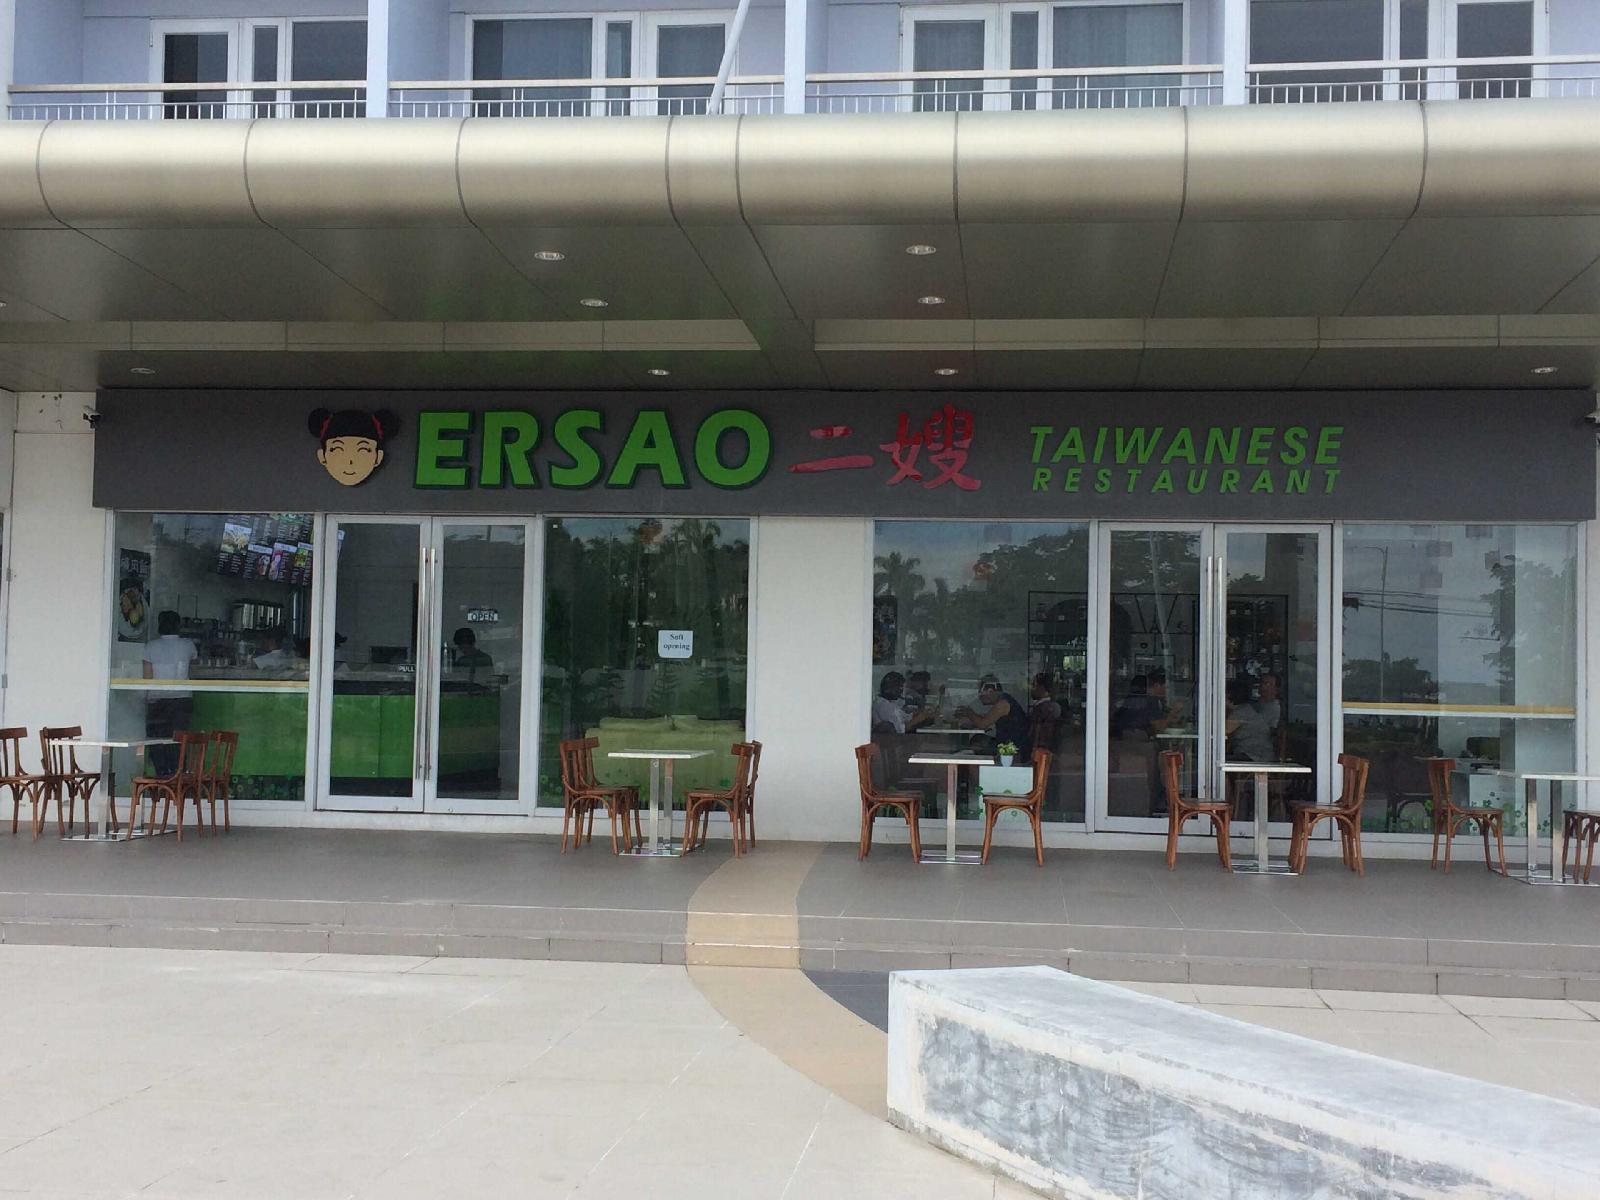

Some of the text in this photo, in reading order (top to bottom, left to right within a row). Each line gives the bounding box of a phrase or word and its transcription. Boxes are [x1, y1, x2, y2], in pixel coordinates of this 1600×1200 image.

[413, 408, 772, 490] ERSAO
[788, 404, 982, 492] 二嫂
[1030, 425, 1345, 466] TAIWANESE
[1032, 467, 1342, 494] RESTAURANT
[472, 612, 495, 622] OPEN
[663, 643, 690, 651] opening
[670, 633, 684, 641] Soft
